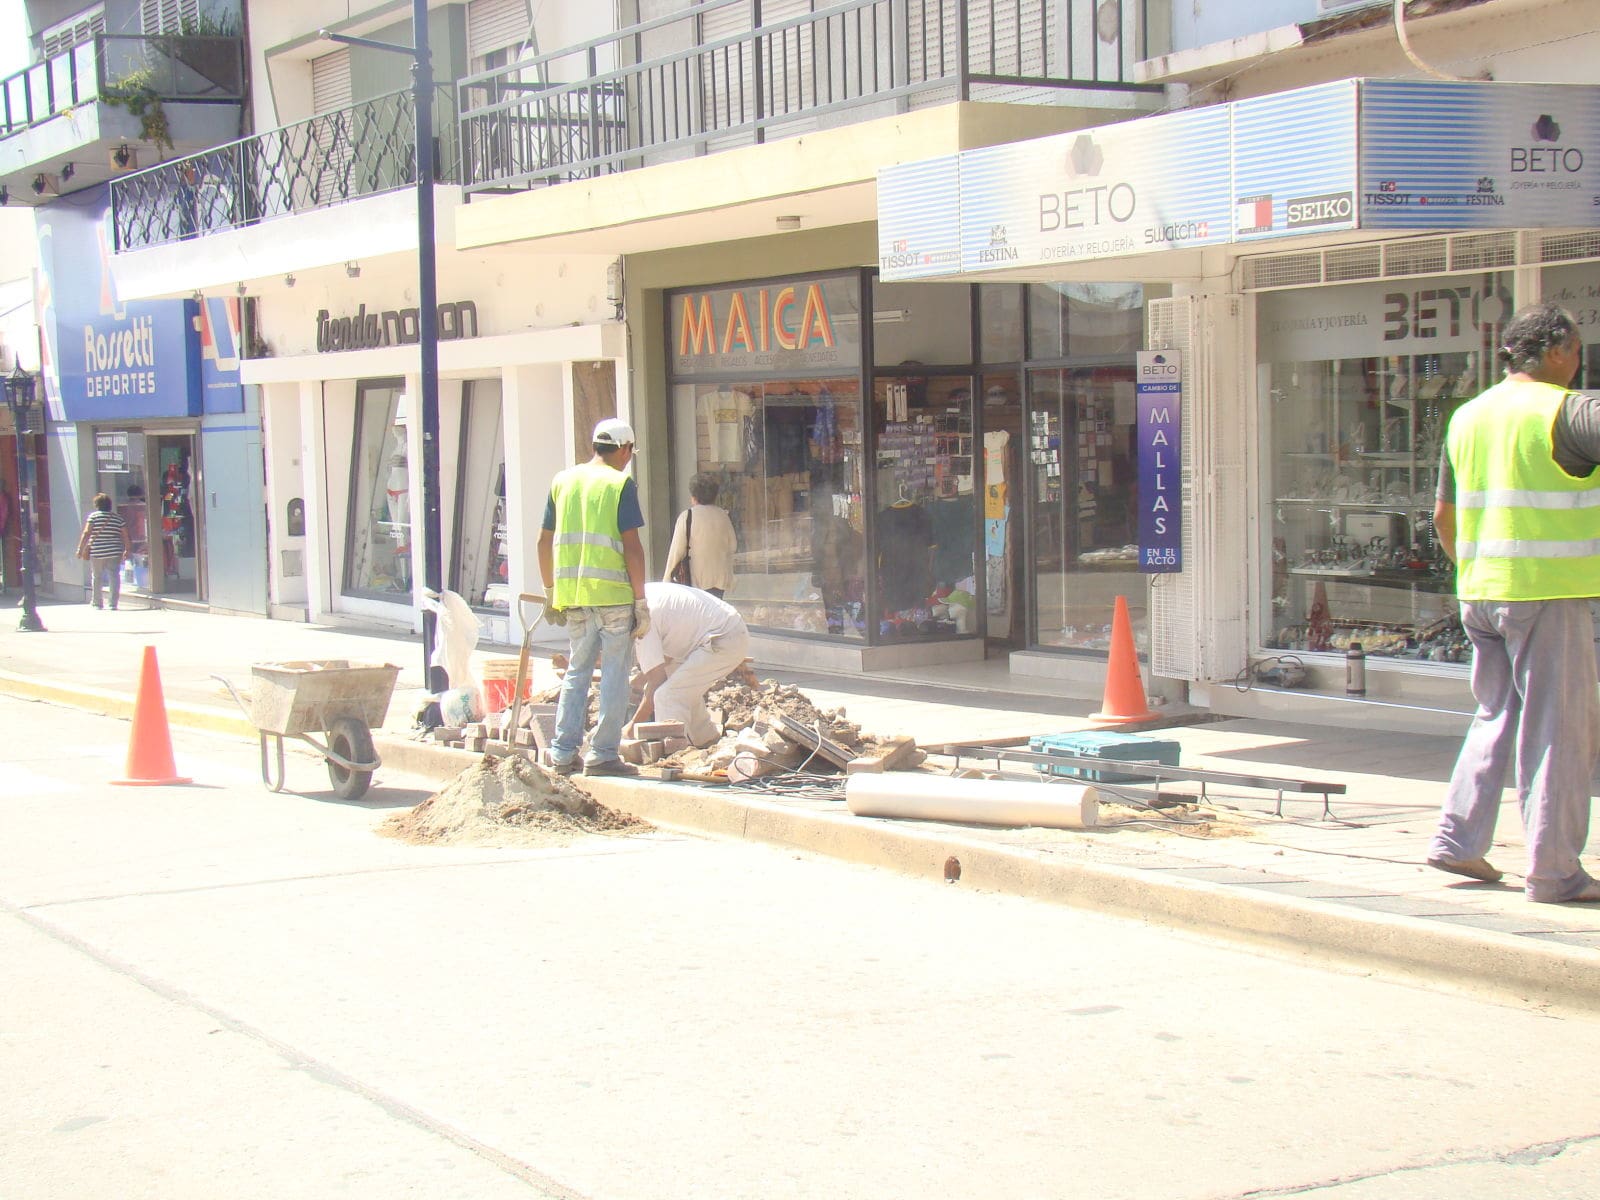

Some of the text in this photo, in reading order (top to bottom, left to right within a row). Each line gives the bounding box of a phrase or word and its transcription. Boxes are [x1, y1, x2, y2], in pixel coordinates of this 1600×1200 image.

[1510, 147, 1584, 173] BETO
[1039, 182, 1136, 233] BETO
[1288, 197, 1351, 223] SEIKO
[1364, 193, 1411, 205] TISSOT
[1466, 194, 1505, 206] FESTINA
[1144, 220, 1198, 244] swatch
[880, 251, 921, 269] TISSOT
[979, 247, 1019, 264] FESTINA
[1039, 236, 1135, 260] JOYERÍA Y RELOJERÍA
[316, 300, 478, 353] tienda noon
[679, 282, 839, 356] MAICA
[85, 315, 155, 373] Rossetti
[1142, 364, 1177, 375] BETO
[87, 371, 156, 398] DEPORTES
[1142, 384, 1168, 392] CAMBIO
[1149, 407, 1170, 535] MALLAS
[1146, 548, 1175, 557] EN EL
[1146, 556, 1176, 566] ACTO
